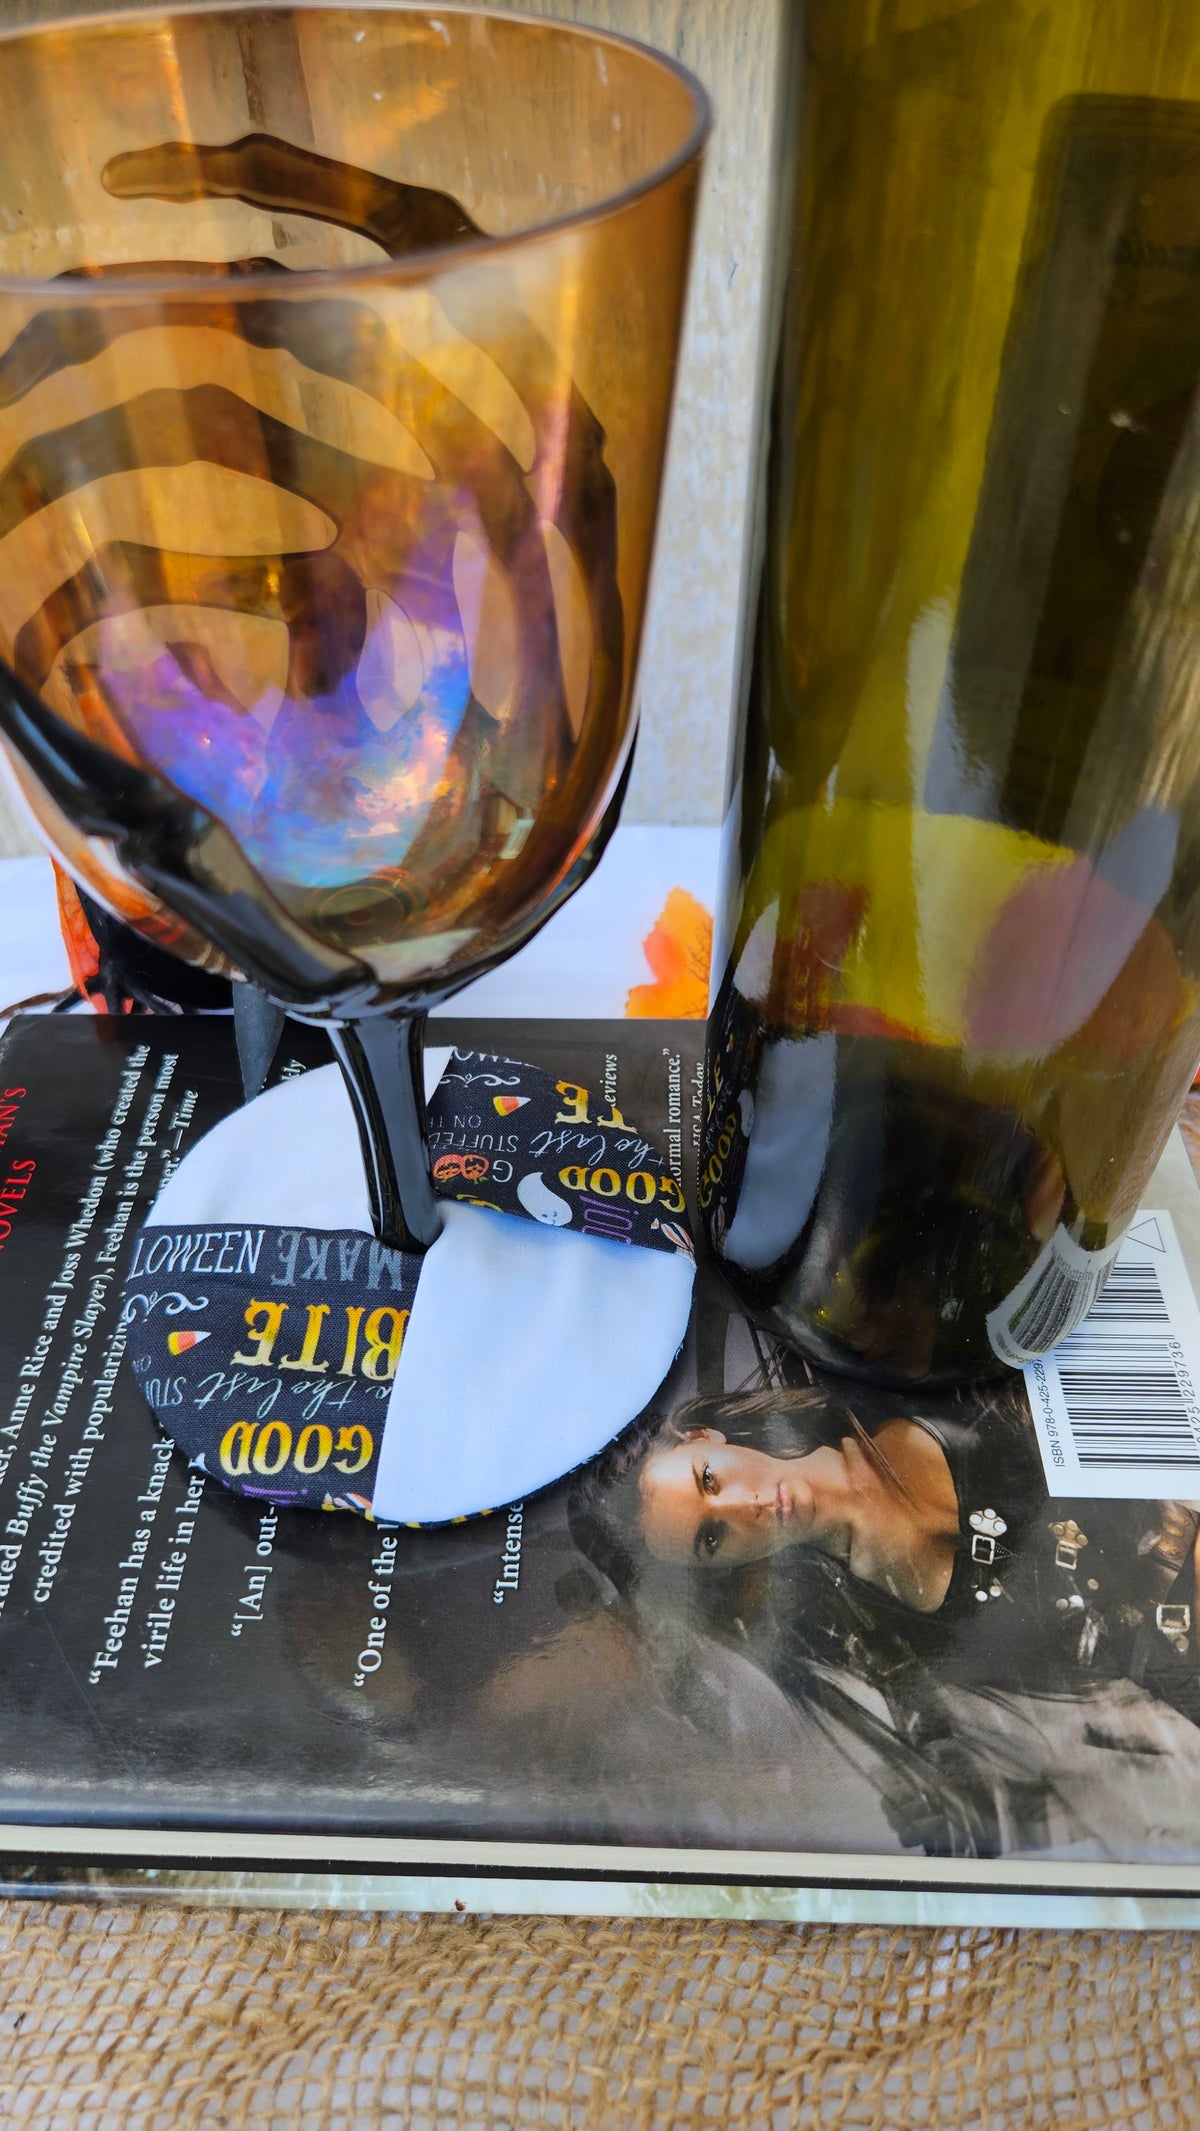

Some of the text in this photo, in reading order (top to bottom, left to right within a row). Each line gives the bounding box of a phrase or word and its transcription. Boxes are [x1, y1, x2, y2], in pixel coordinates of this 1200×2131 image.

[122, 1044, 151, 1068] the
[154, 1053, 179, 1090] most
[600, 1054, 618, 1107] eviews
[109, 1070, 145, 1126] created
[662, 1048, 682, 1124] romance.”
[135, 1093, 167, 1147] person
[91, 1128, 122, 1171] (who
[123, 1150, 149, 1178] the
[531, 1130, 607, 1166] last
[0, 1159, 37, 1252] OVELS
[63, 1176, 108, 1249] Whedon
[114, 1181, 140, 1197] is
[558, 1165, 687, 1214] GOOD
[94, 1201, 134, 1264] Feehan
[50, 1252, 82, 1289] Joss
[43, 1294, 68, 1330] and
[71, 1268, 115, 1340] Slayer),
[19, 1335, 52, 1378] Rice
[229, 1298, 411, 1382] BITE
[40, 1343, 87, 1427] Vampire
[194, 1371, 283, 1419] last
[1168, 1340, 1196, 1397] 229736
[1, 1383, 36, 1439] Anne
[292, 1378, 358, 1421] the
[29, 1434, 58, 1468] the
[31, 1503, 76, 1603] credited
[63, 1447, 94, 1497] with
[82, 1312, 128, 1441] popularizin
[219, 1420, 375, 1477] GOOD
[1050, 1440, 1066, 1467] ISBN
[5, 1473, 48, 1537] Buffy
[175, 1476, 206, 1514] her
[168, 1521, 195, 1545] in
[371, 1536, 398, 1575] the
[492, 1502, 524, 1604] “Intense
[88, 1437, 176, 1685] “Feehan has a knack
[155, 1551, 188, 1591] life
[230, 1565, 273, 1637] “[An]
[255, 1501, 279, 1557] out-
[368, 1580, 392, 1610] of
[140, 1598, 176, 1669] virile
[353, 1616, 387, 1687] “One
